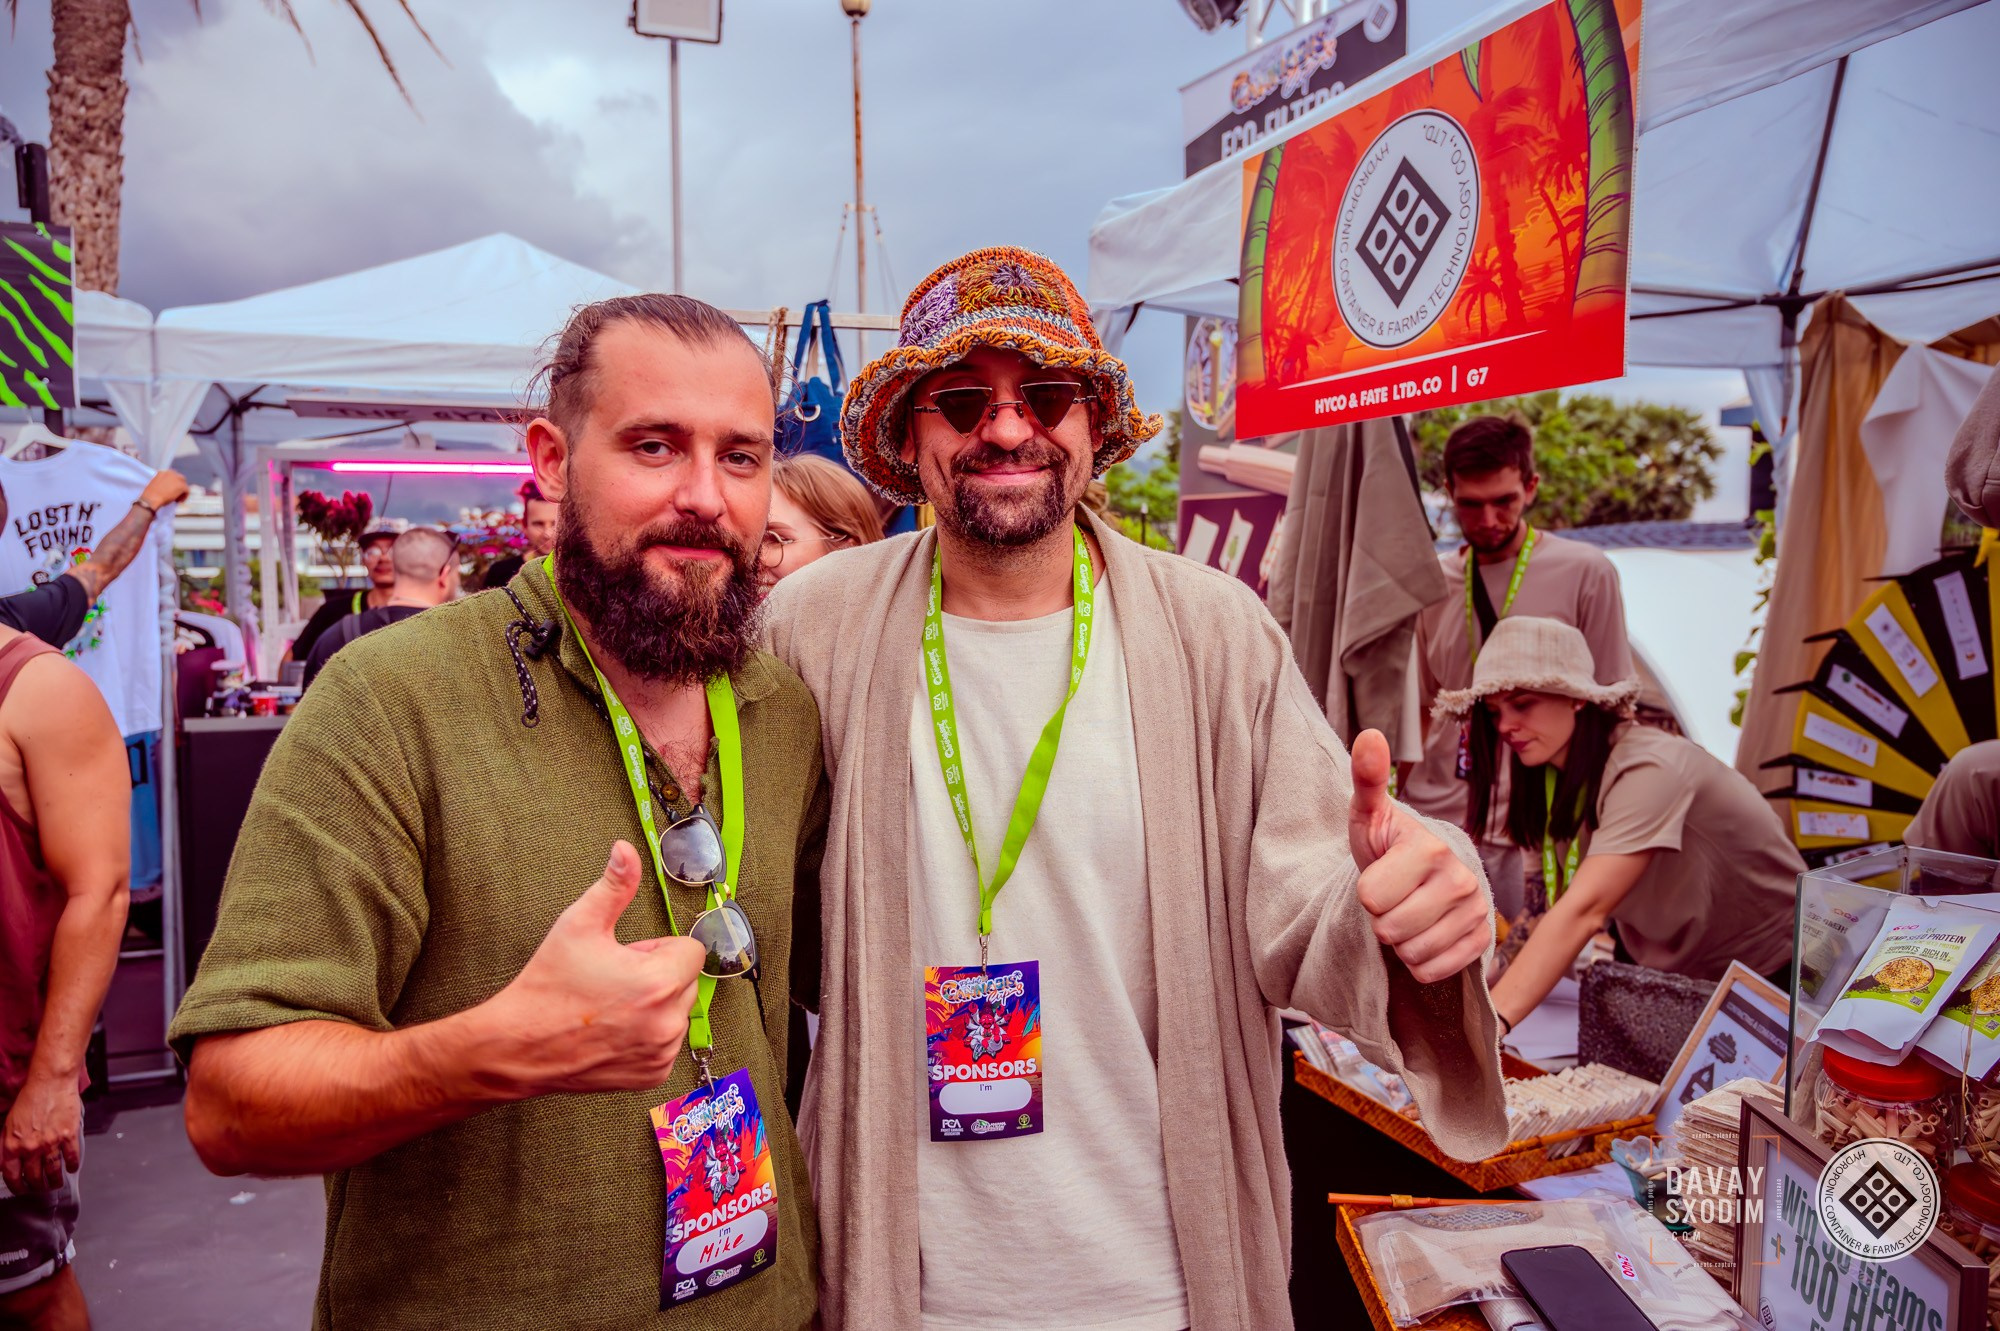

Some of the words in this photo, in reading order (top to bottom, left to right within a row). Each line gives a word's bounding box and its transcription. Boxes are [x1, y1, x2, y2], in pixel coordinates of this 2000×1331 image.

[1339, 141, 1390, 254] HYDROPONIC
[1427, 178, 1471, 313] TECHNOLOGY
[1339, 258, 1377, 331] CONTAINER
[1376, 321, 1384, 336] &
[1387, 305, 1428, 337] FARMS
[1315, 394, 1347, 415] HYCO
[1348, 392, 1359, 409] &
[1360, 386, 1389, 407] FATE
[1466, 366, 1489, 387] G7
[14, 503, 74, 538] LOST
[24, 525, 93, 559] FOUND
[933, 693, 942, 711] PCA
[1922, 947, 1941, 956] RICH
[1940, 951, 1951, 959] IN
[1927, 933, 1967, 944] PROTEIN
[940, 975, 1017, 1003] CANNABIS
[932, 1057, 1037, 1082] SPONSORS
[979, 1082, 993, 1092] I'm
[942, 1118, 962, 1129] PCA
[671, 1181, 773, 1244] SPONSORS
[1781, 1173, 1819, 1245] Win
[698, 1232, 747, 1264] Mike
[718, 1225, 732, 1239] I'm
[675, 1277, 696, 1293] PCA
[1789, 1234, 1839, 1323] 100
